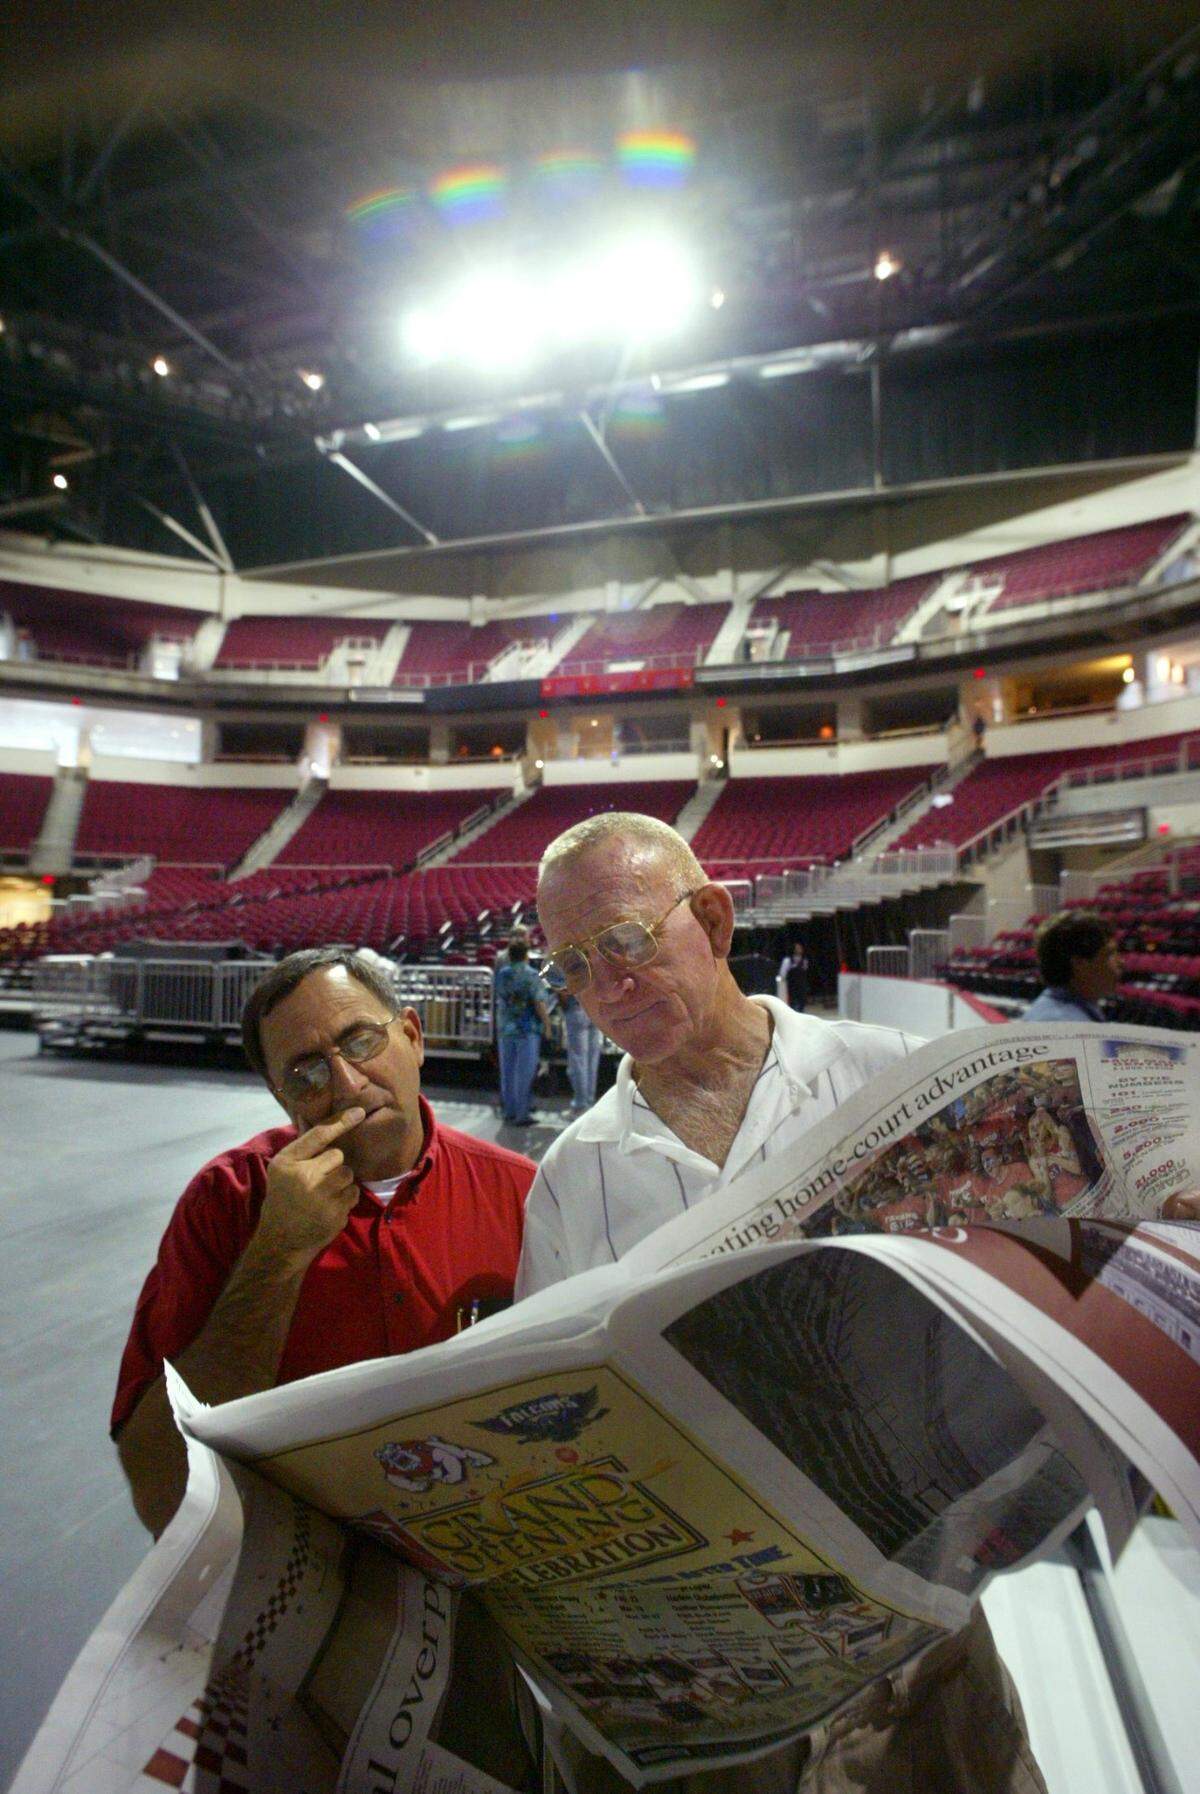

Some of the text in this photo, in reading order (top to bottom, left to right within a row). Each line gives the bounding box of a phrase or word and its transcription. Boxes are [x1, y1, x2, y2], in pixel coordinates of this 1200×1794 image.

[700, 1044, 1049, 1258] ting home-court advantage
[420, 1473, 630, 1550] GRAND
[450, 1498, 656, 1572] OPENING
[488, 1523, 684, 1587] LEBRATION
